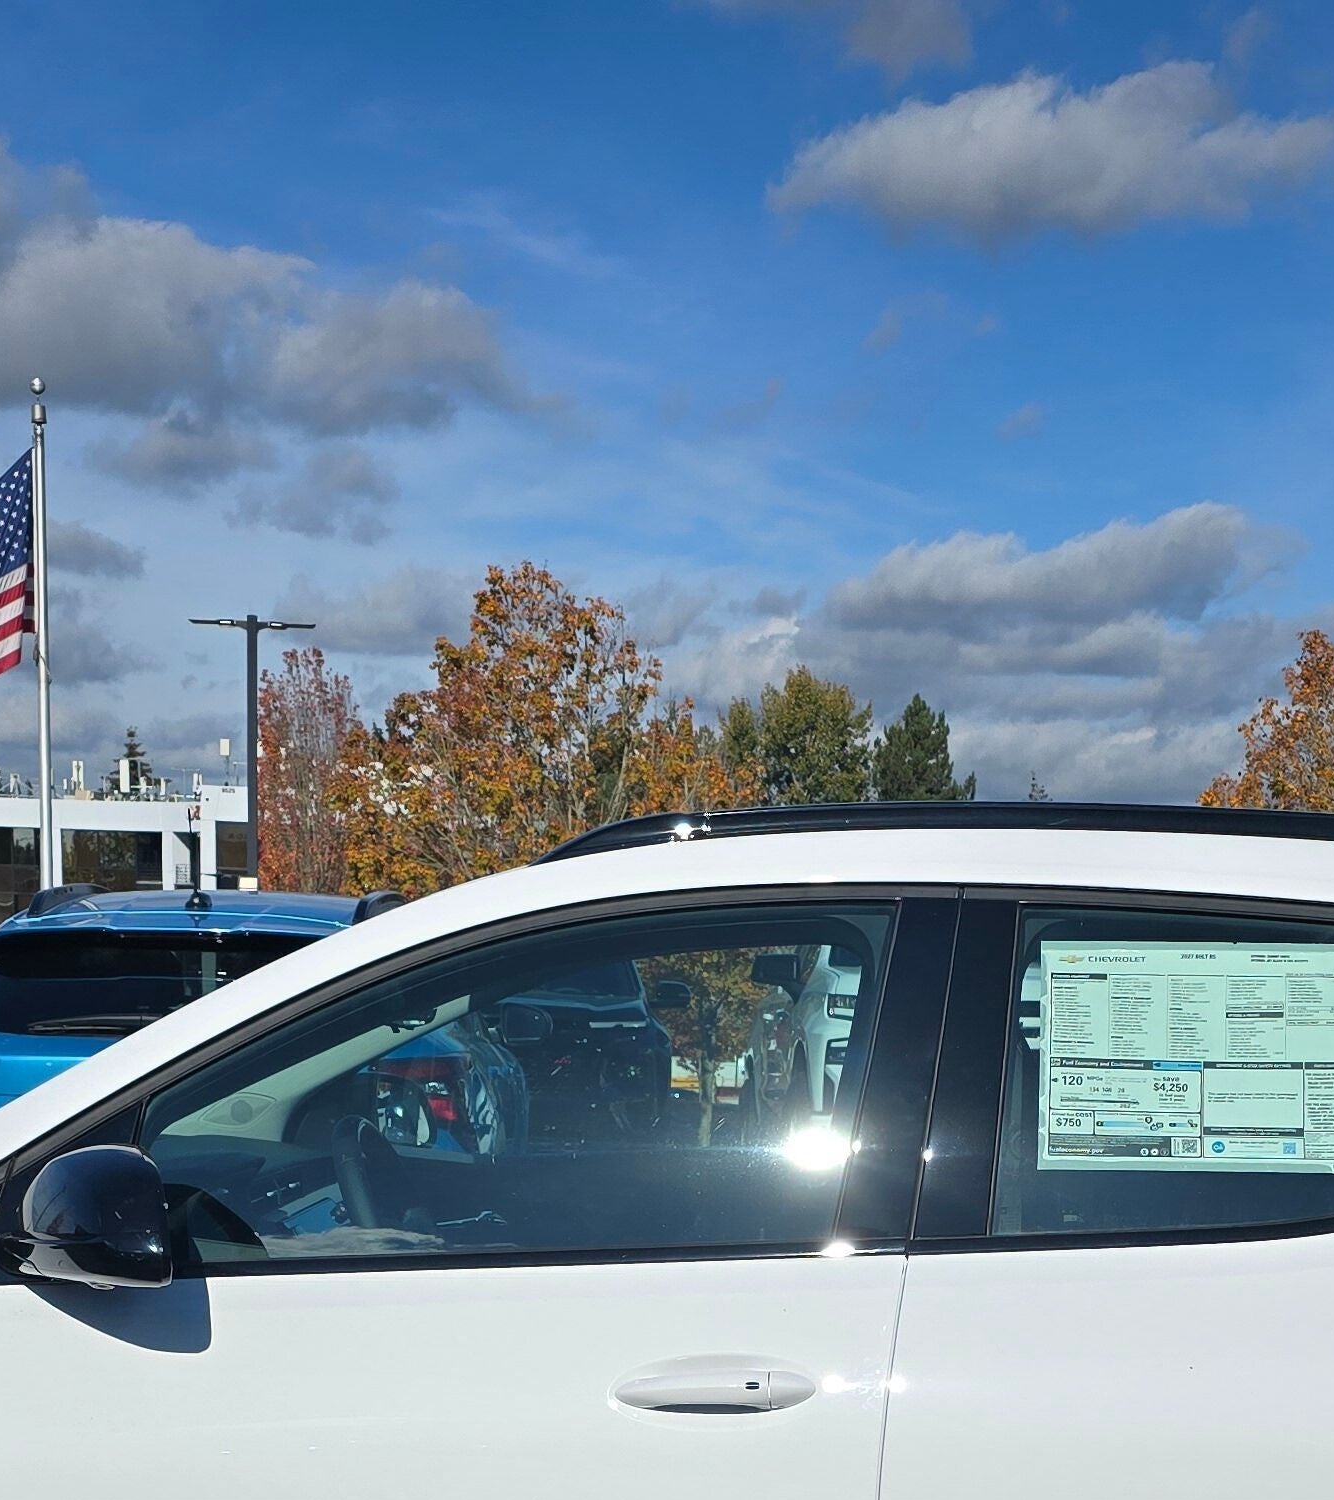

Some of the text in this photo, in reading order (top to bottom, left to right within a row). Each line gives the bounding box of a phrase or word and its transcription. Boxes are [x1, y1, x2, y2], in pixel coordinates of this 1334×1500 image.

[1088, 955, 1146, 963] CHEVROLET
[1061, 1075, 1084, 1086] 120
[1153, 1082, 1189, 1093] $4,250
[1055, 1117, 1082, 1127] $750
